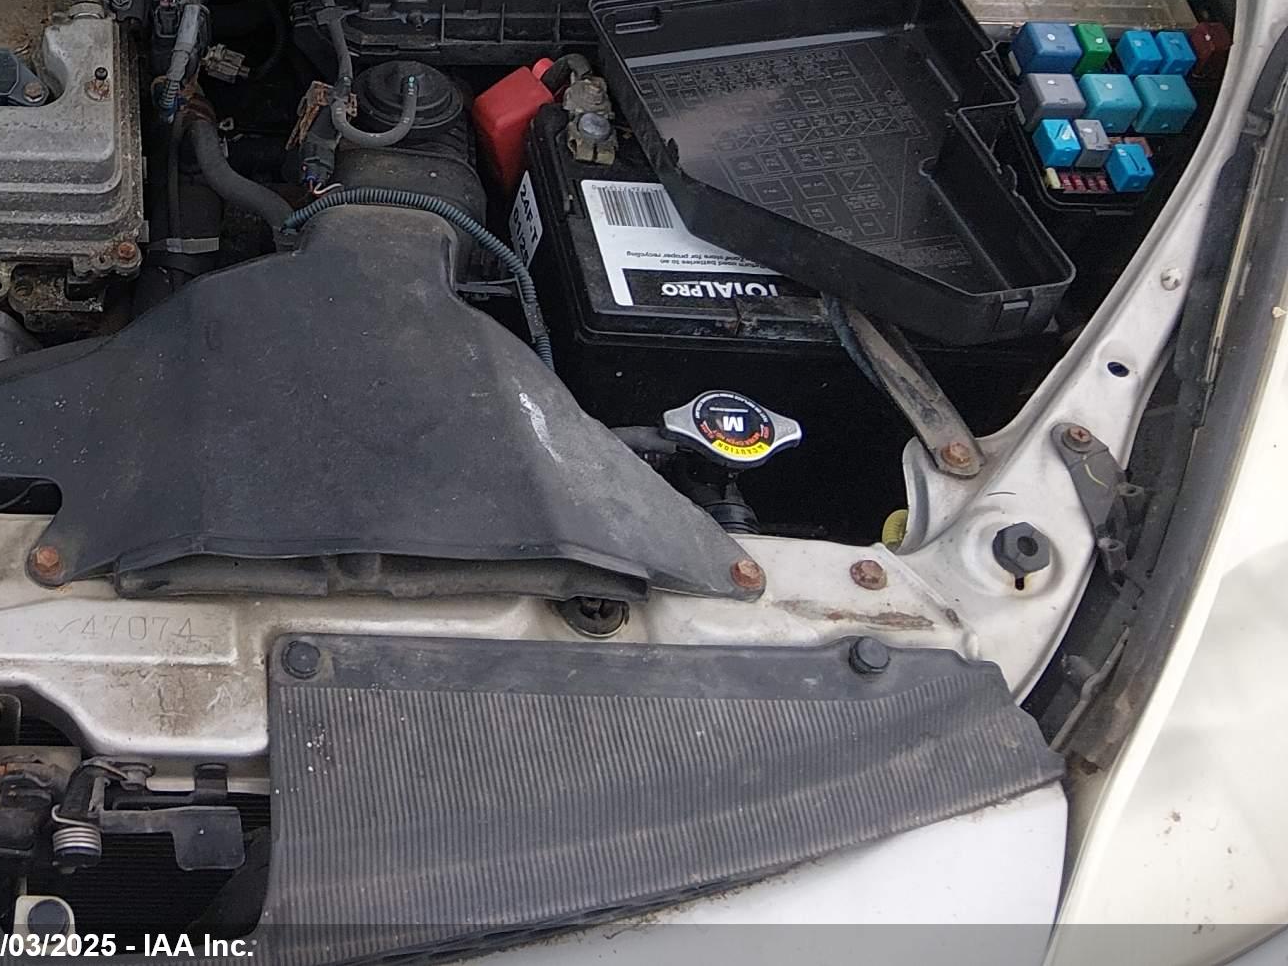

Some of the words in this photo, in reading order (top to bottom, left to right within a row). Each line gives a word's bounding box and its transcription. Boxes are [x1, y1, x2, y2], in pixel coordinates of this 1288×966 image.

[626, 250, 661, 259] recycling
[663, 252, 689, 260] proper
[81, 615, 194, 643] 47074
